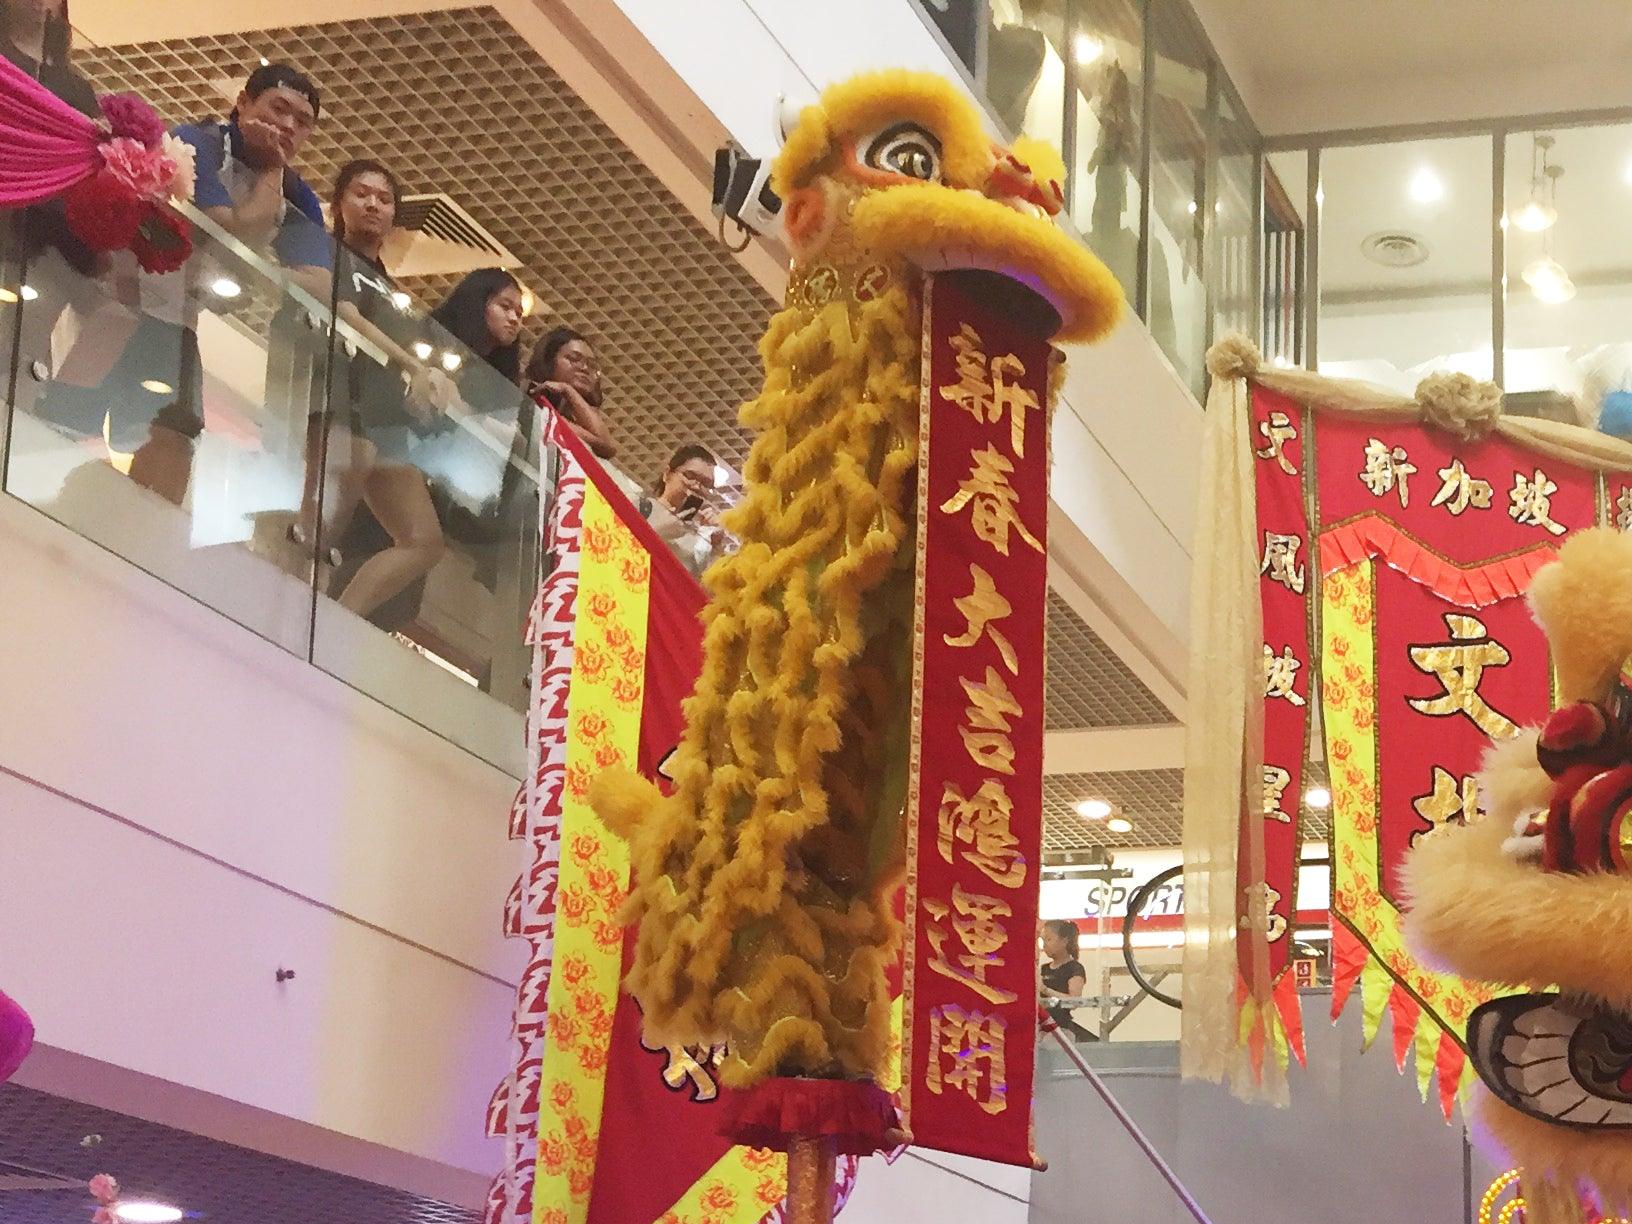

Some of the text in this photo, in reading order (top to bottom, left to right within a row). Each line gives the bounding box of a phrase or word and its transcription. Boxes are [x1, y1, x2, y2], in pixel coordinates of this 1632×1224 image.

[1358, 437, 1567, 536] 新加坡
[923, 322, 1045, 1115] 新春大吉鴻運開
